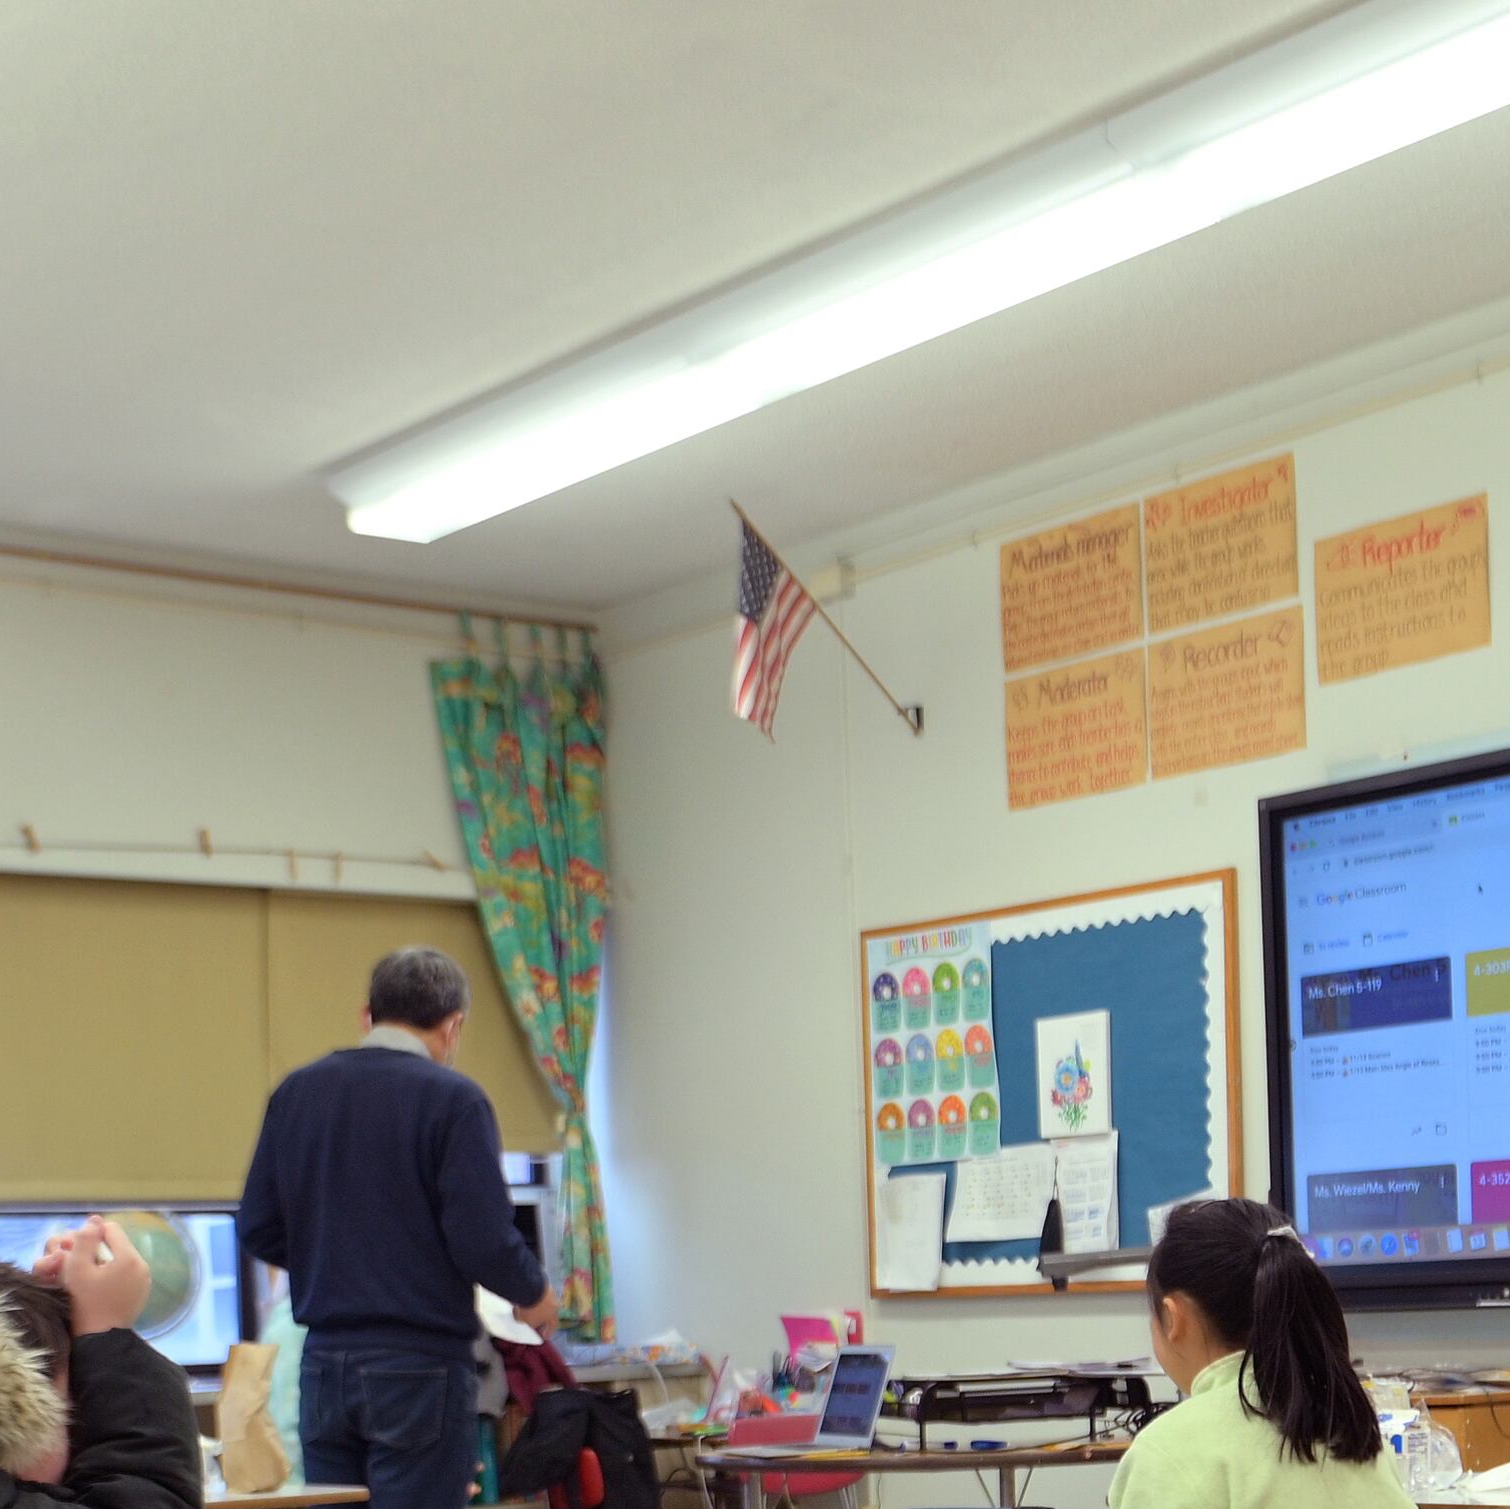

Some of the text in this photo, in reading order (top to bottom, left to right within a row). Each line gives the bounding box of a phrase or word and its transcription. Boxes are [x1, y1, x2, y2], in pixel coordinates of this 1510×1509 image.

[1181, 477, 1270, 524] Investigator
[1362, 518, 1447, 578] Reporter
[1319, 557, 1442, 607] Communicates the
[1183, 630, 1260, 673] Recorder
[1038, 672, 1108, 710] Moderator
[1316, 882, 1407, 907] Google Classroom
[886, 928, 971, 957] HAPPY BIRTHDAY
[1308, 978, 1383, 1000] Ms. Chen 5-119
[1315, 1185, 1331, 1200] Ms.
[1388, 1179, 1420, 1196] Kenny
[1479, 1173, 1510, 1187] 4-352
